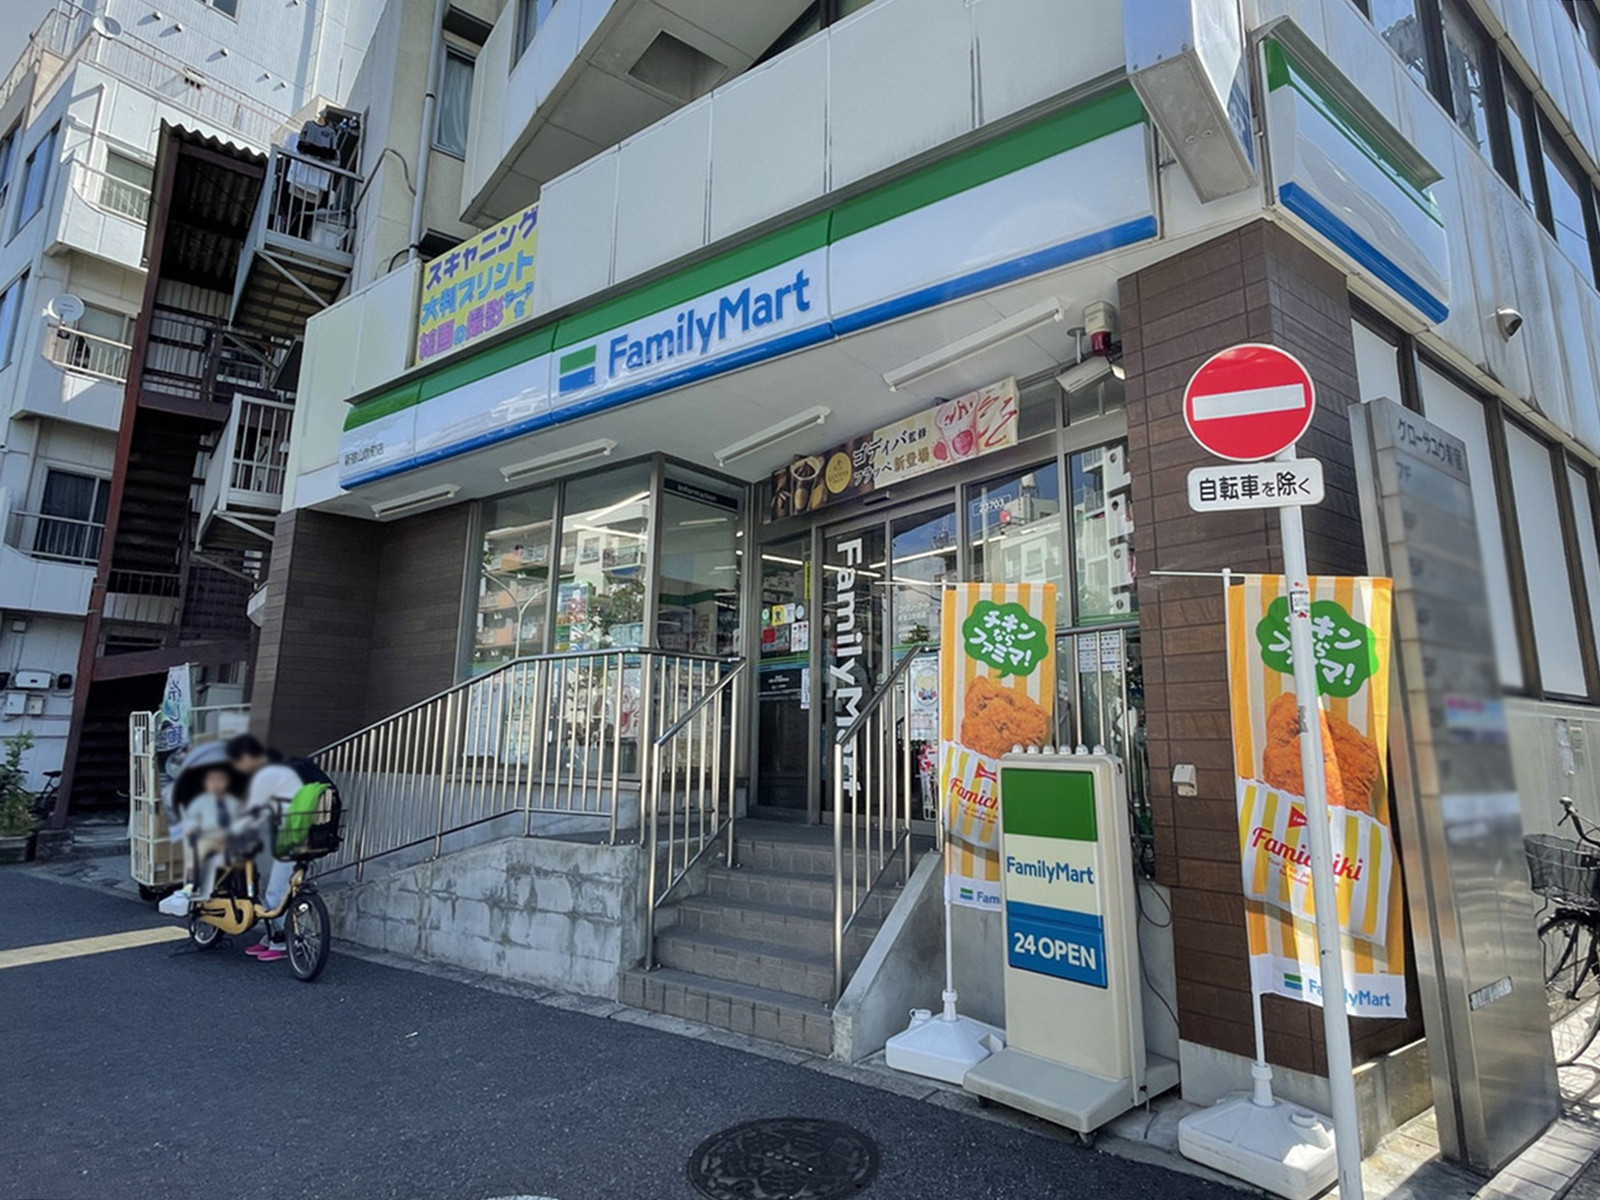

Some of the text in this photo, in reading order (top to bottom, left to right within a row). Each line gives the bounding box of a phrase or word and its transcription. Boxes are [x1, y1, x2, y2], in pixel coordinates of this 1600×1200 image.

[426, 205, 539, 290] スキャニング
[609, 269, 809, 379] FamilyMart
[852, 427, 928, 467] ゴディバ監修
[1199, 471, 1311, 502] 自転車を除く
[983, 610, 1037, 641] チキン
[993, 628, 1016, 647] なら
[1284, 614, 1362, 651] キン
[969, 626, 1032, 667] ファミマ!
[830, 538, 863, 798] FamilyMrt
[1006, 856, 1095, 885] FamilyMart
[1308, 978, 1392, 1008] FalyMart
